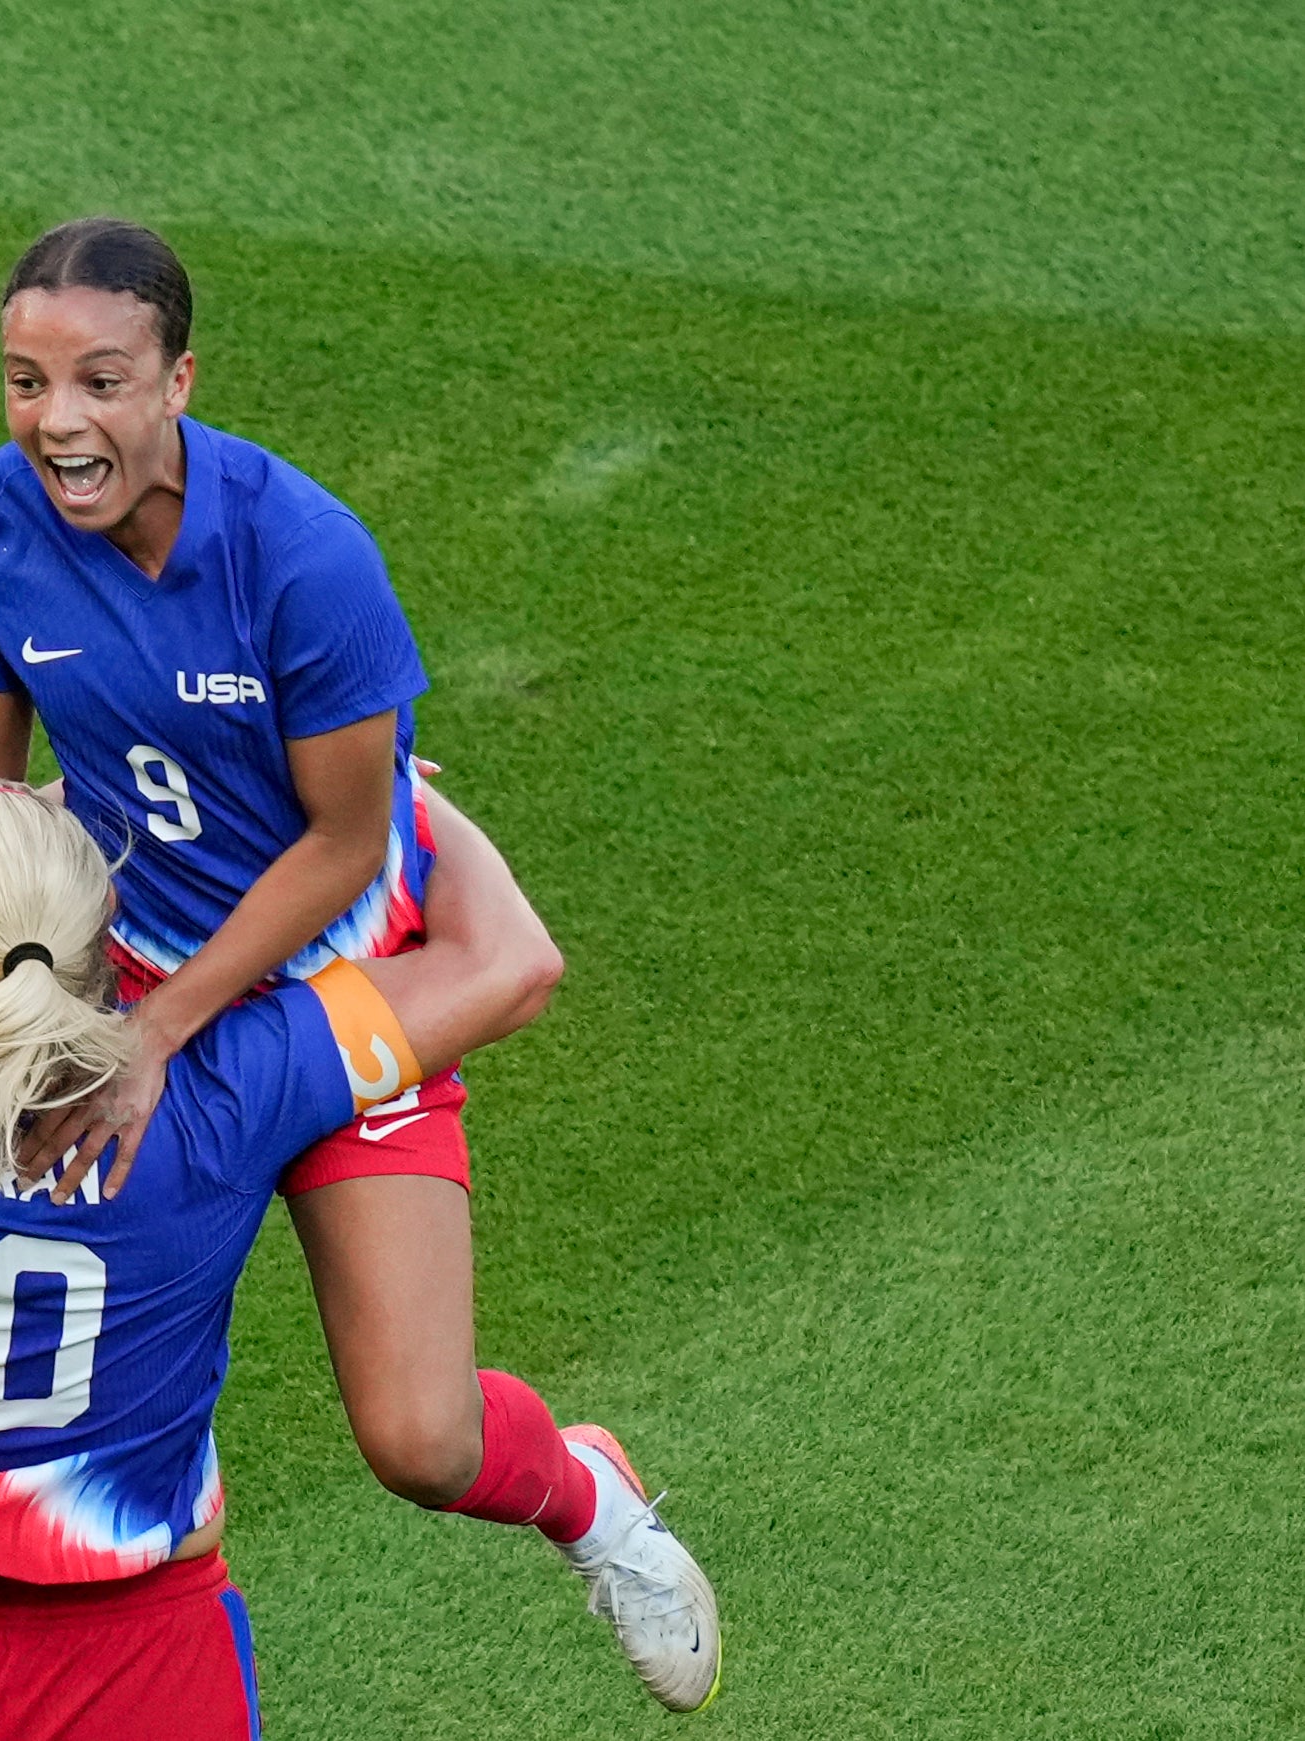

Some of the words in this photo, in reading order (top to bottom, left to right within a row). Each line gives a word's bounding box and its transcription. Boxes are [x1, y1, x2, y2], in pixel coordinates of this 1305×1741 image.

[176, 670, 267, 705] USA
[125, 743, 203, 843] 9
[337, 1033, 401, 1100] C
